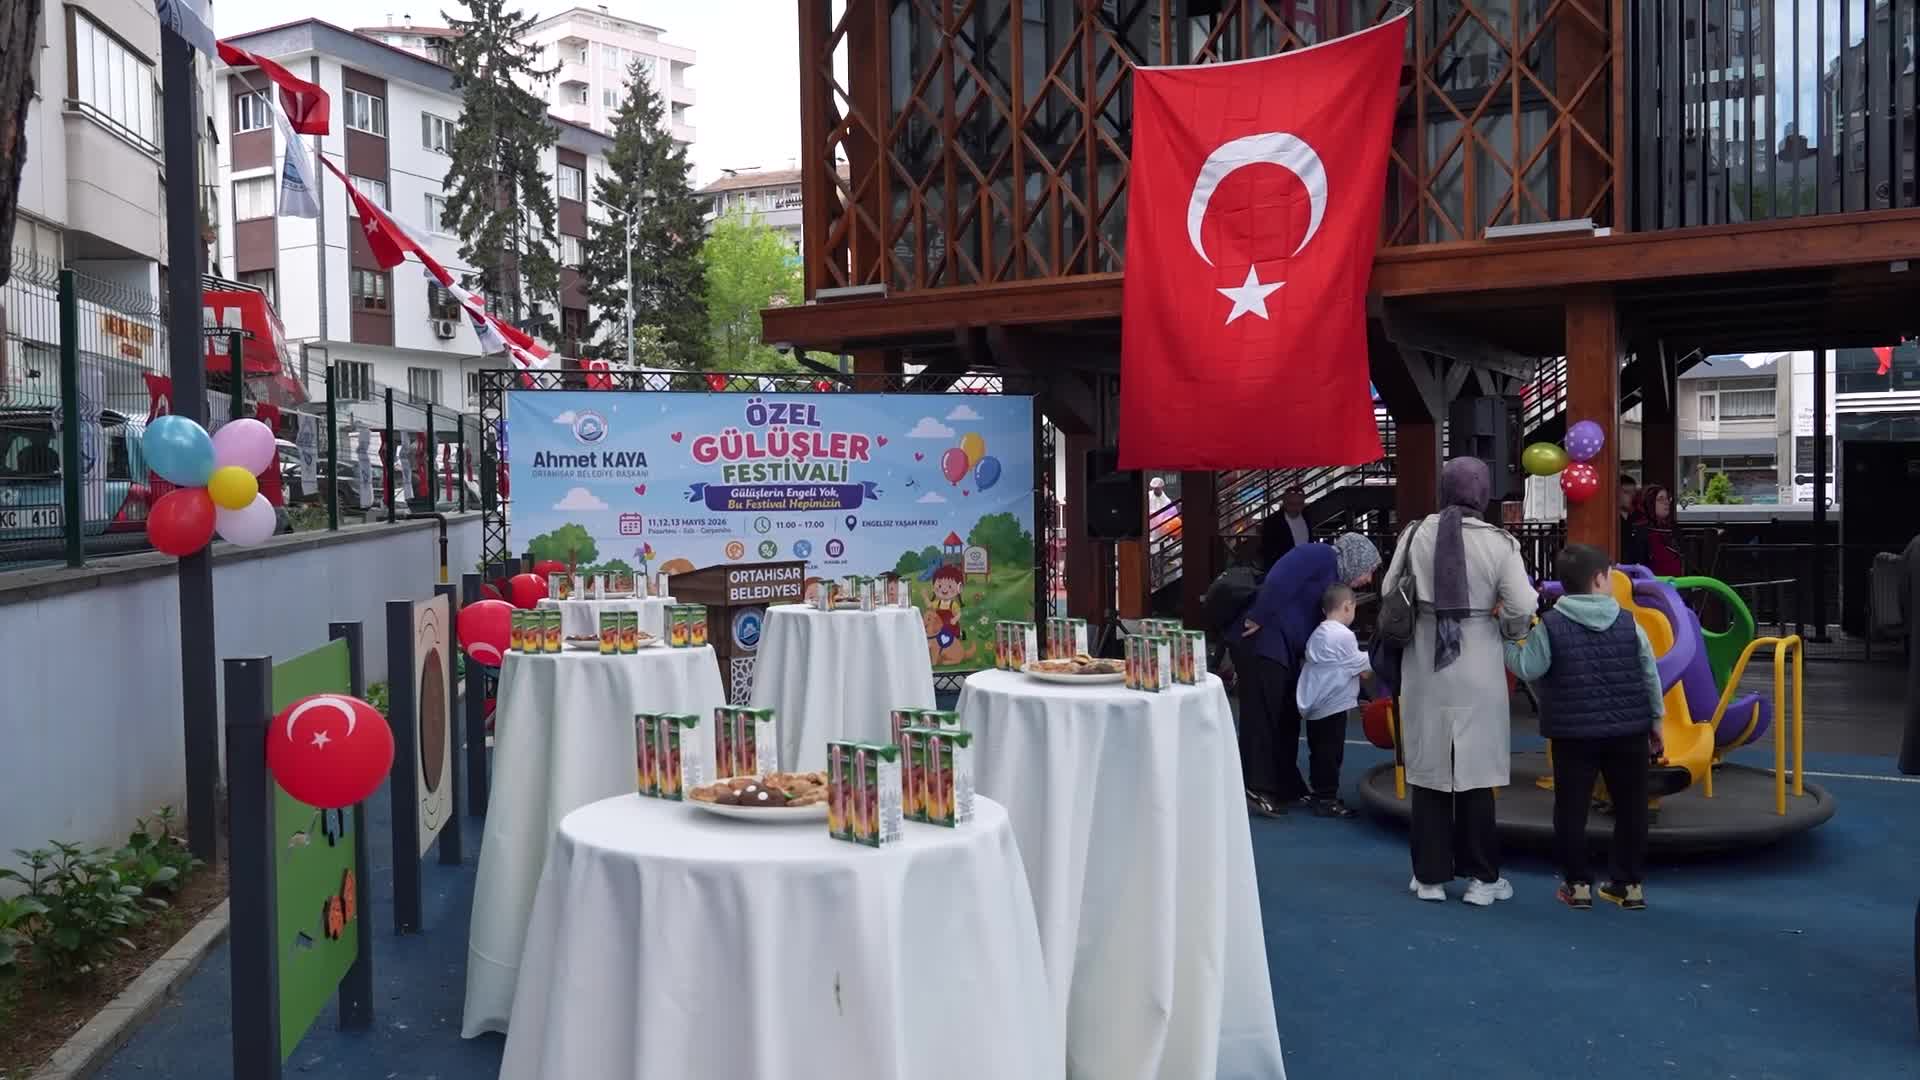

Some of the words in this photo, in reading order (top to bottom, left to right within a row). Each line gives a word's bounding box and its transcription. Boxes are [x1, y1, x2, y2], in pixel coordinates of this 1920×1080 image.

[746, 397, 821, 427] ÖZEL
[692, 426, 870, 464] GÜLÜŞLER
[533, 450, 597, 468] Ahmet
[602, 451, 648, 468] KAYA
[722, 457, 848, 484] FESTİVALİ
[730, 487, 785, 500] Gülüşlerin
[787, 488, 817, 501] Engeli
[818, 487, 840, 499] Yok,
[727, 499, 743, 510] Bu
[745, 498, 787, 510] Festival
[789, 499, 841, 512] Hepimizin
[32, 510, 58, 526] 410
[682, 518, 706, 527] MAYIS
[708, 517, 728, 526] 2026
[776, 521, 796, 529] 11.00
[805, 520, 825, 529] 17.00
